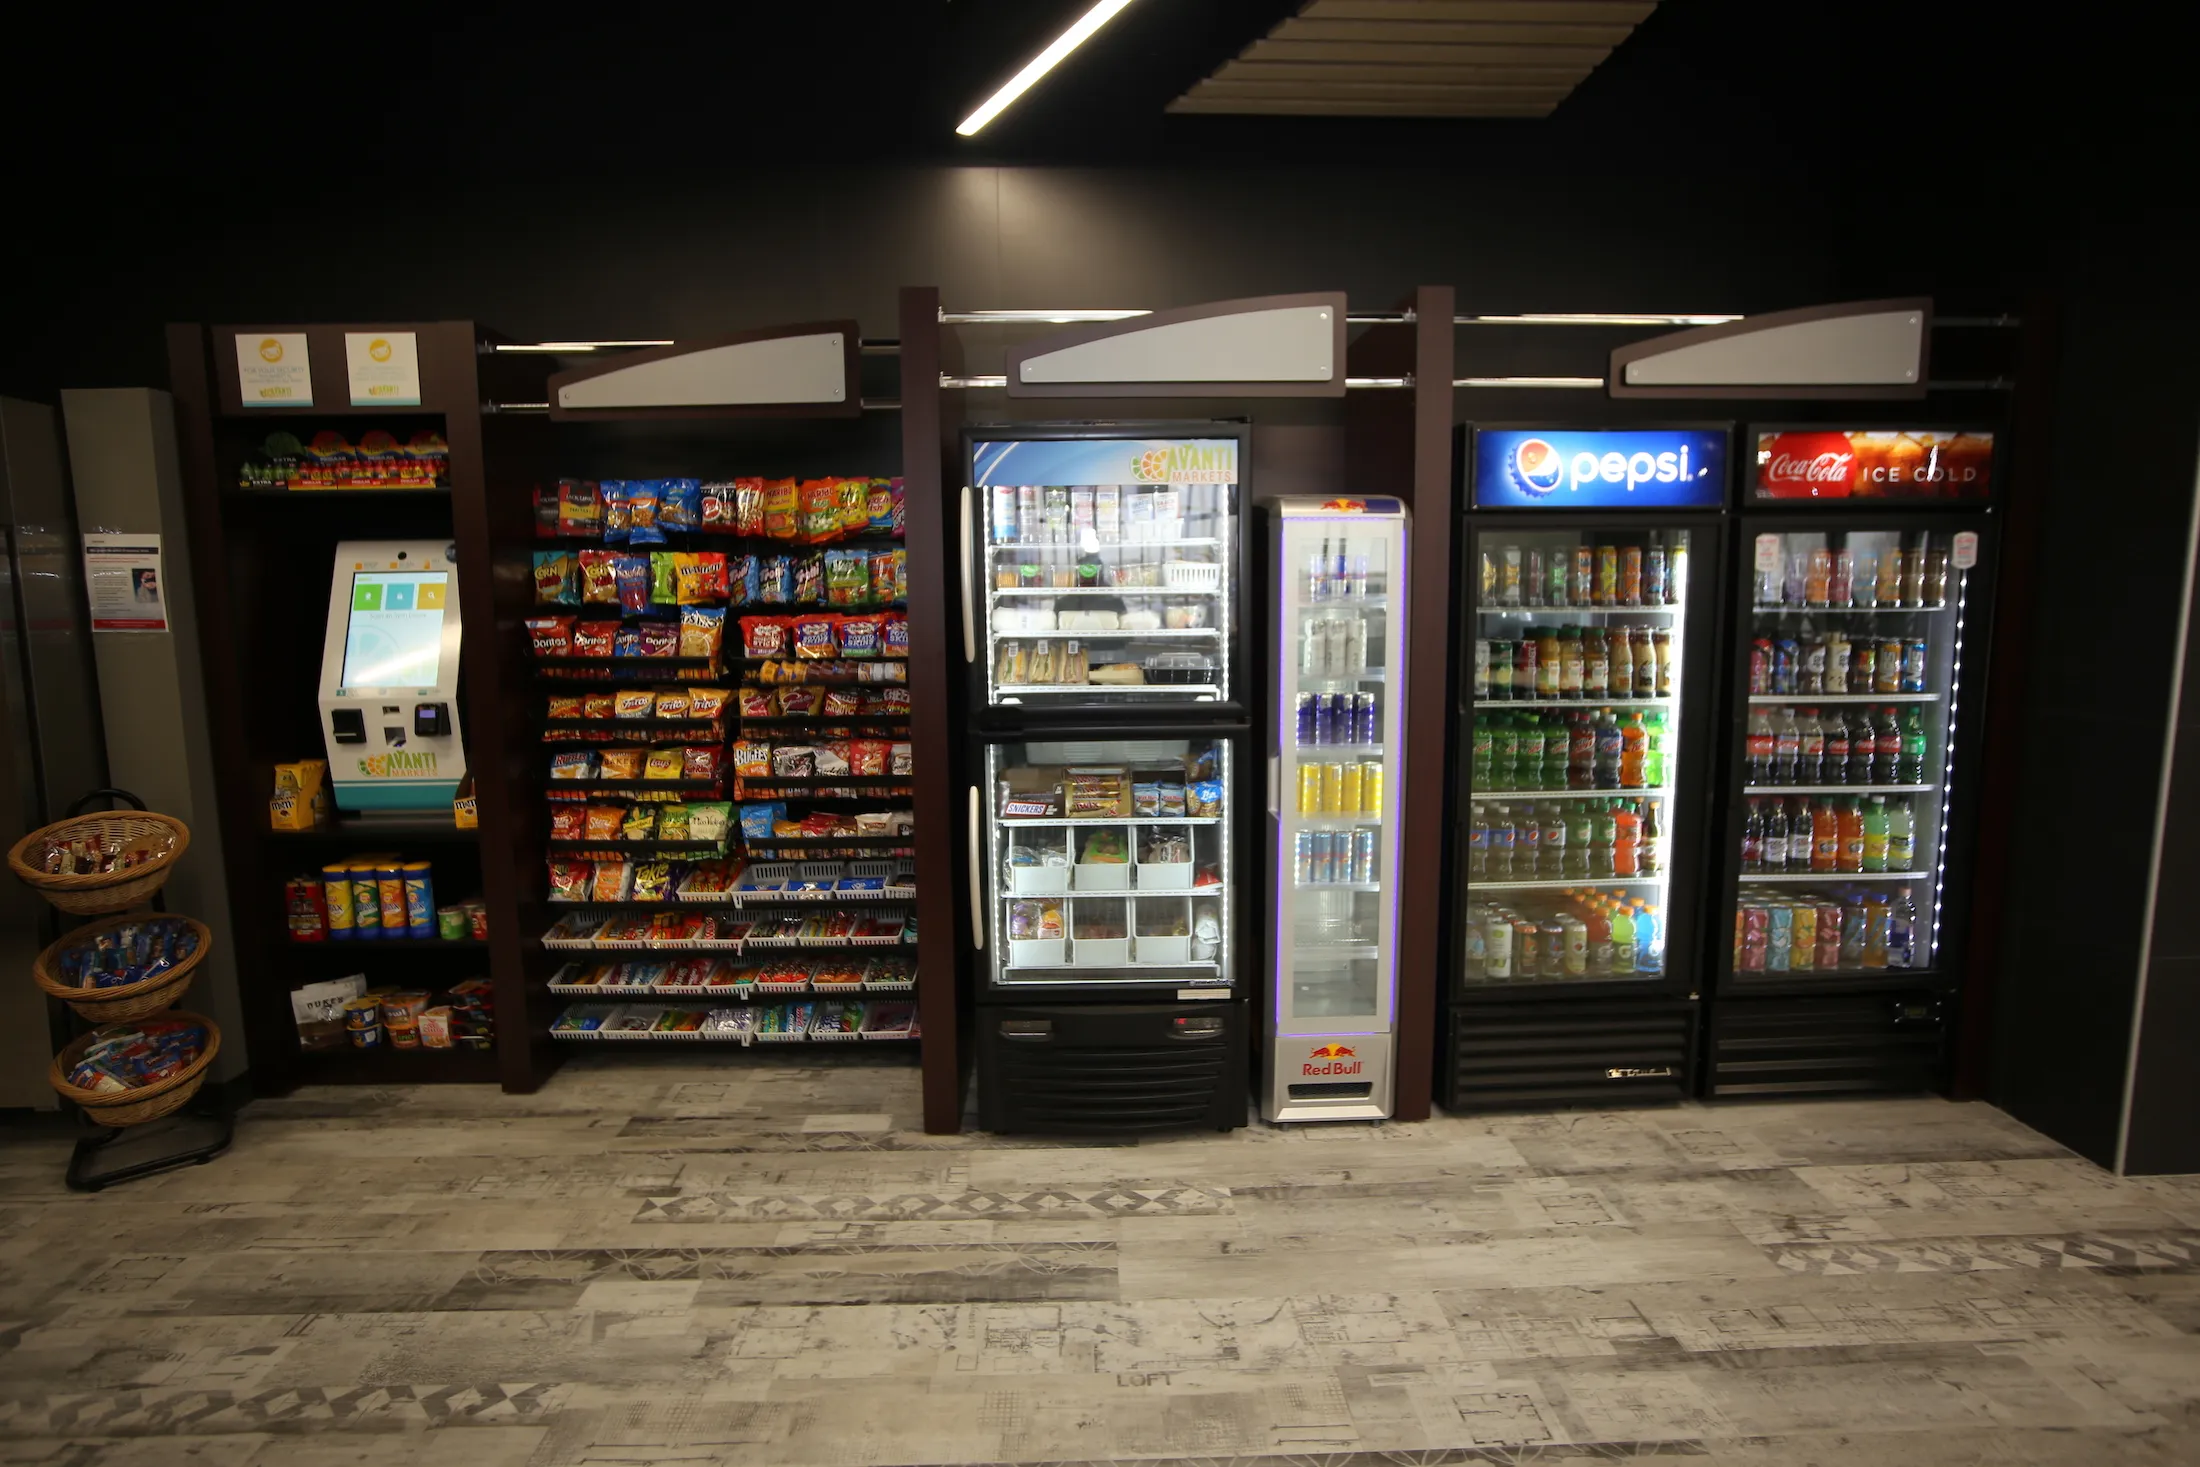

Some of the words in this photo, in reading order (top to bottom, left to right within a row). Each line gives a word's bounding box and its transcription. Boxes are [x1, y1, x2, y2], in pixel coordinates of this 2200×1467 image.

[1166, 443, 1233, 481] AVANTI
[1570, 444, 1689, 491] pepsi
[1769, 452, 1853, 483] Coca-Cola
[1172, 471, 1232, 482] MARKETS
[1862, 467, 1900, 482] ICE
[1914, 466, 1977, 482] COLD
[766, 487, 793, 498] HARIBO
[534, 566, 558, 579] CORN
[533, 636, 567, 649] Doritos
[574, 632, 608, 646] Doritos
[646, 636, 678, 646] Doritos
[622, 698, 648, 709] Fritos
[660, 701, 686, 712] Fritos
[694, 697, 720, 708] Fritos
[386, 750, 438, 777] AVANTI
[604, 758, 636, 766] BAKED
[736, 748, 768, 766] BUGLES
[392, 769, 438, 777] MARKETS
[1008, 804, 1044, 814] SNICKERS
[634, 862, 670, 880] Takis
[306, 996, 345, 1010] DUKE'S
[1302, 1062, 1331, 1076] Red
[1334, 1062, 1361, 1074] Bull
[1116, 1373, 1171, 1387] LOFT
